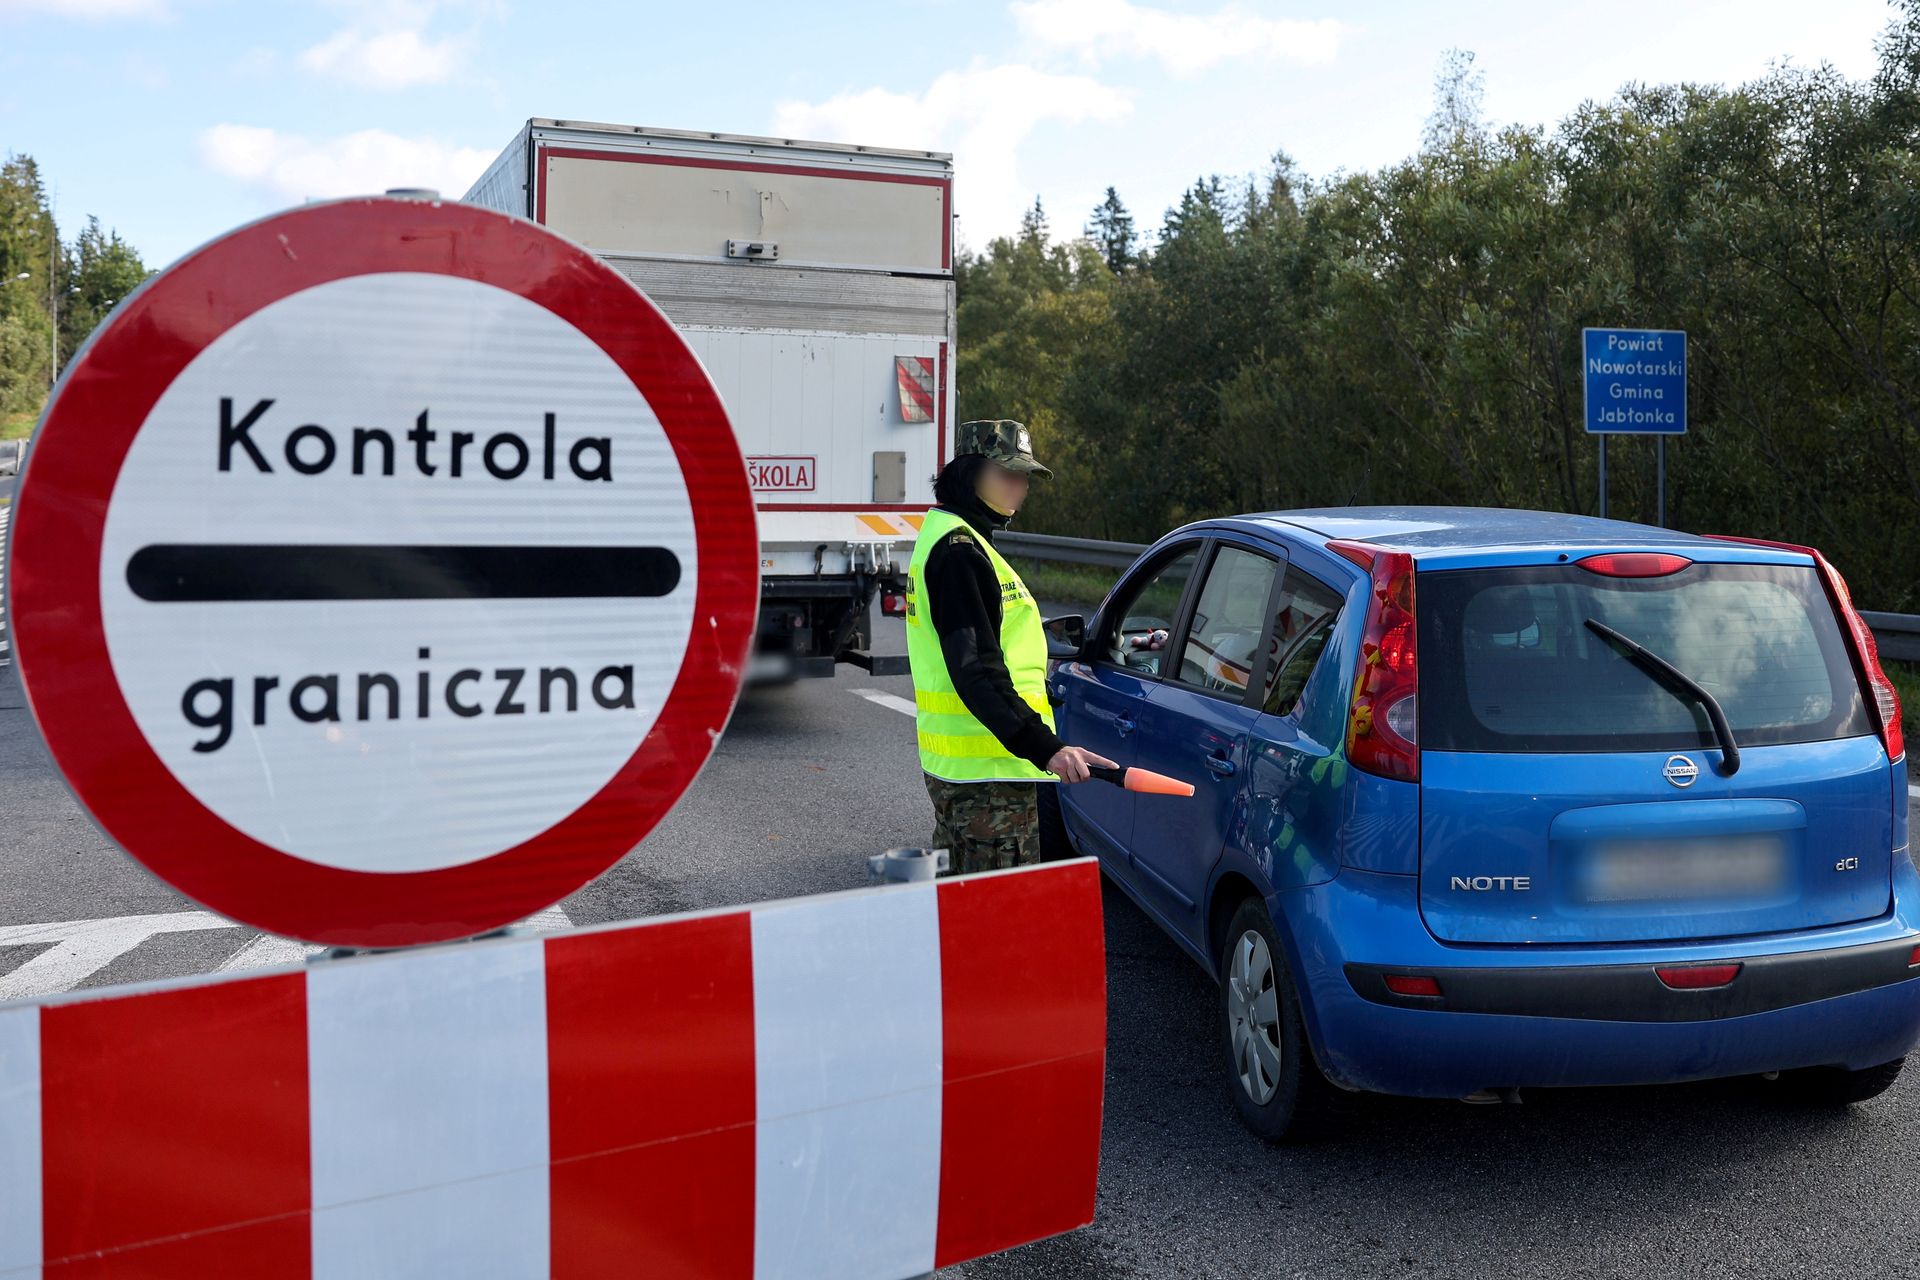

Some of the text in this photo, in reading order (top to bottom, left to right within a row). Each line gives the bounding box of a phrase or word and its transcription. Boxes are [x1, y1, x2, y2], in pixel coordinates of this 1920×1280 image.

[1608, 334, 1663, 352] Powiat
[1589, 358, 1682, 376] Nowotarski
[1609, 383, 1664, 399] Gmina
[1597, 406, 1675, 424] Jabłonka
[218, 397, 613, 482] Kontrola
[181, 647, 636, 754] graniczna
[1667, 767, 1696, 775] NISSAN
[1835, 857, 1858, 871] dCi
[1451, 876, 1530, 891] NOTE
